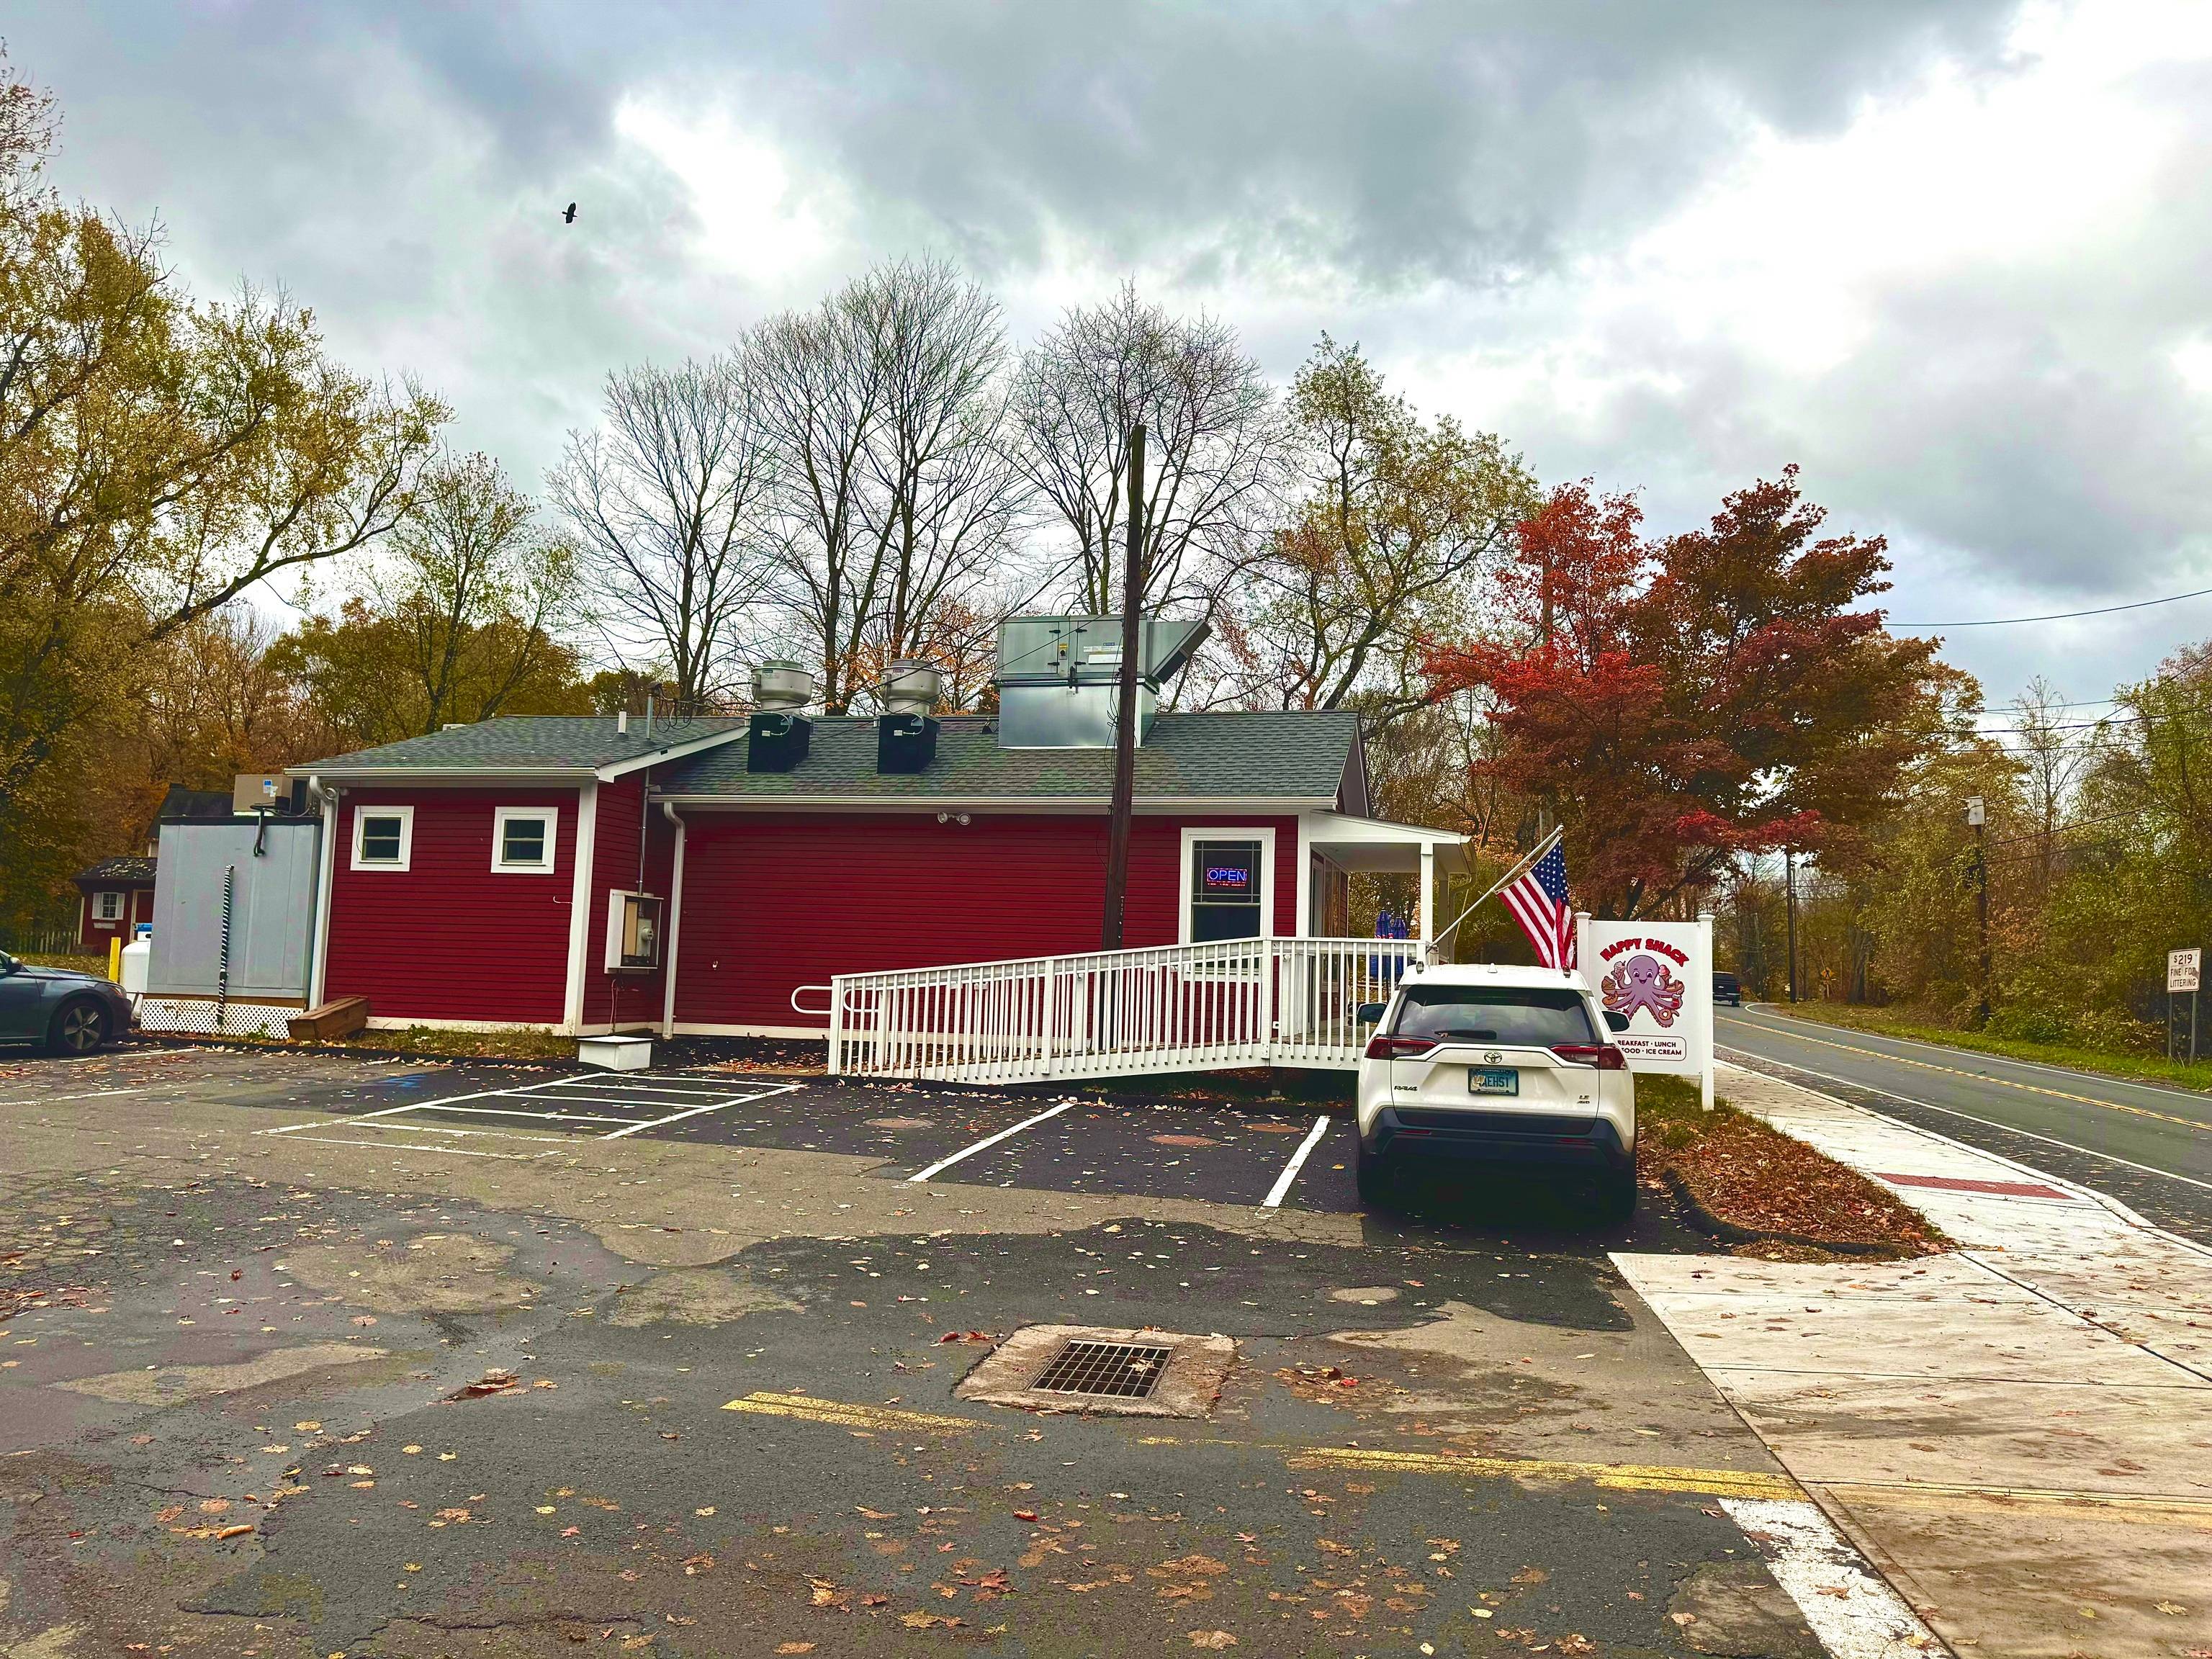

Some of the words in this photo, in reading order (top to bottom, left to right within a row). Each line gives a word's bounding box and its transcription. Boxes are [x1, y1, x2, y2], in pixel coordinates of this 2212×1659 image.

[1208, 869, 1246, 881] OPEN
[1600, 938, 1642, 962] HAPPY
[1645, 938, 1689, 967] SHACK
[2174, 954, 2193, 965] $219
[2170, 968, 2182, 976] FINE
[2170, 979, 2196, 987] LITTERING
